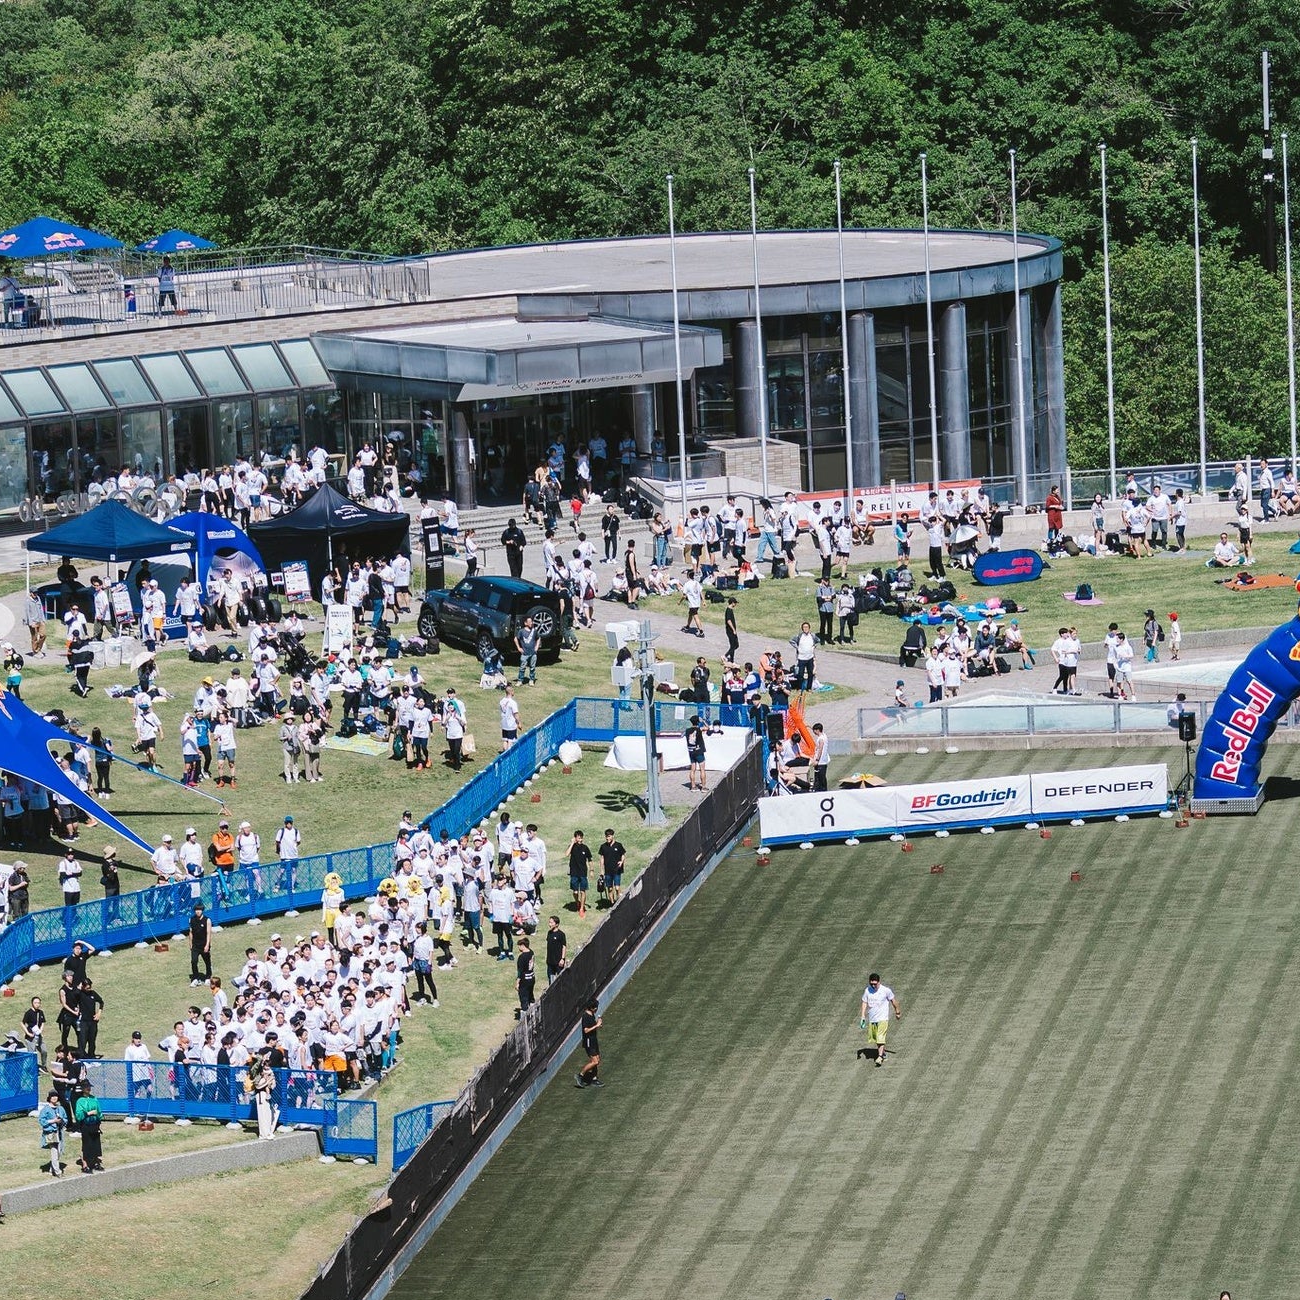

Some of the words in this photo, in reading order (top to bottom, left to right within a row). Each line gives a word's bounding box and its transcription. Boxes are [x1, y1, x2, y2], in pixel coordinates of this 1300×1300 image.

[871, 501, 912, 511] RELVE
[1230, 677, 1277, 735] Bull
[1211, 728, 1250, 783] Red
[911, 787, 1017, 809] BFGoodrich
[1045, 780, 1154, 798] DEFENDER
